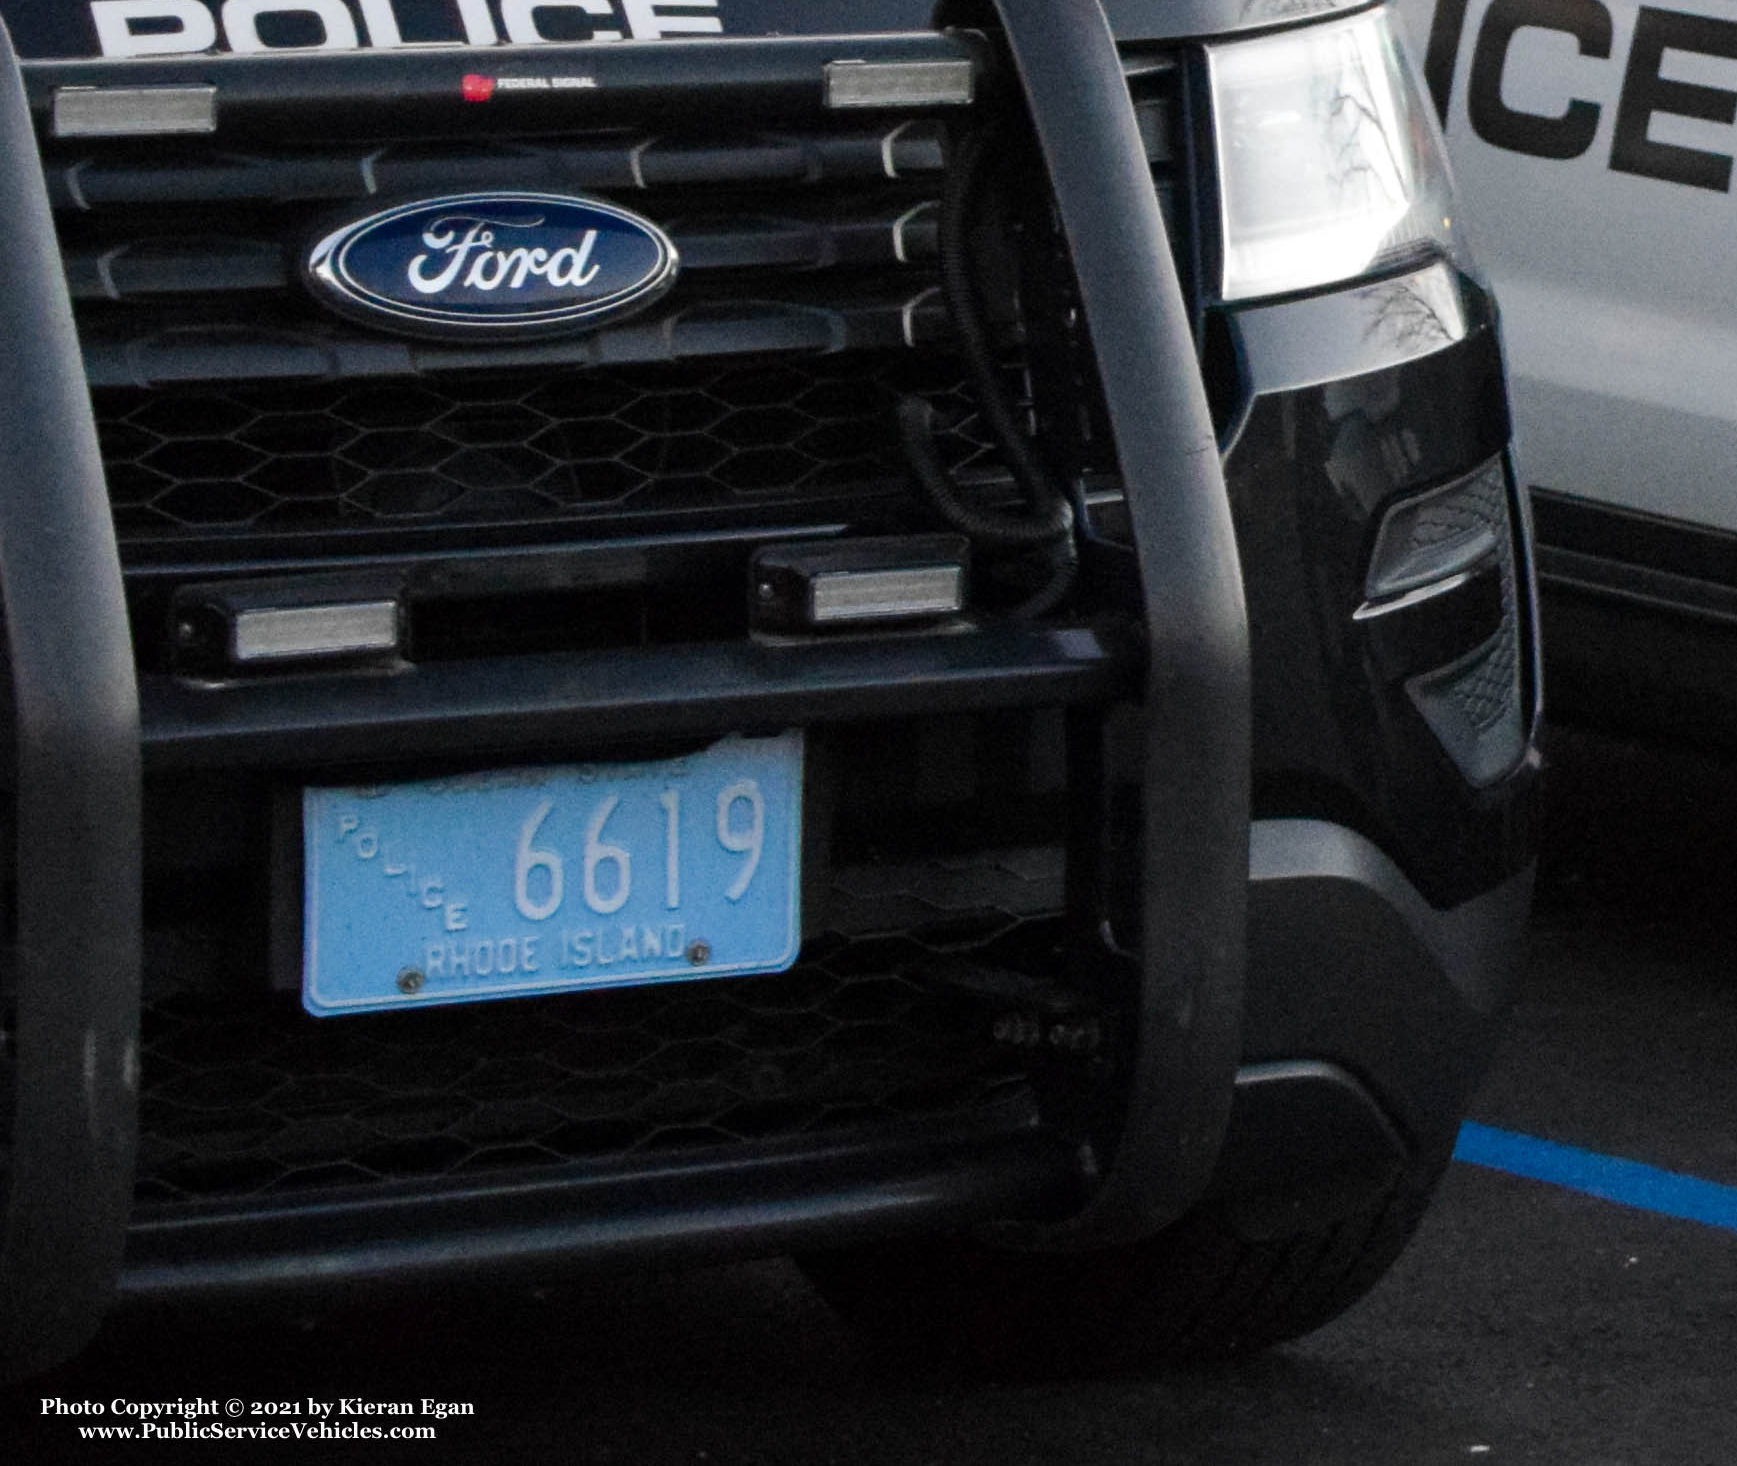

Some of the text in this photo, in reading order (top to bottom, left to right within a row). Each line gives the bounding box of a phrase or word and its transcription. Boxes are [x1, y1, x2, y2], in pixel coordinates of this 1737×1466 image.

[497, 77, 597, 89] FEDERAL SIGNAL
[408, 216, 600, 294] Ford
[337, 812, 470, 932] POLICE
[513, 777, 766, 922] 6619
[423, 922, 688, 977] RHODE ISLAND
